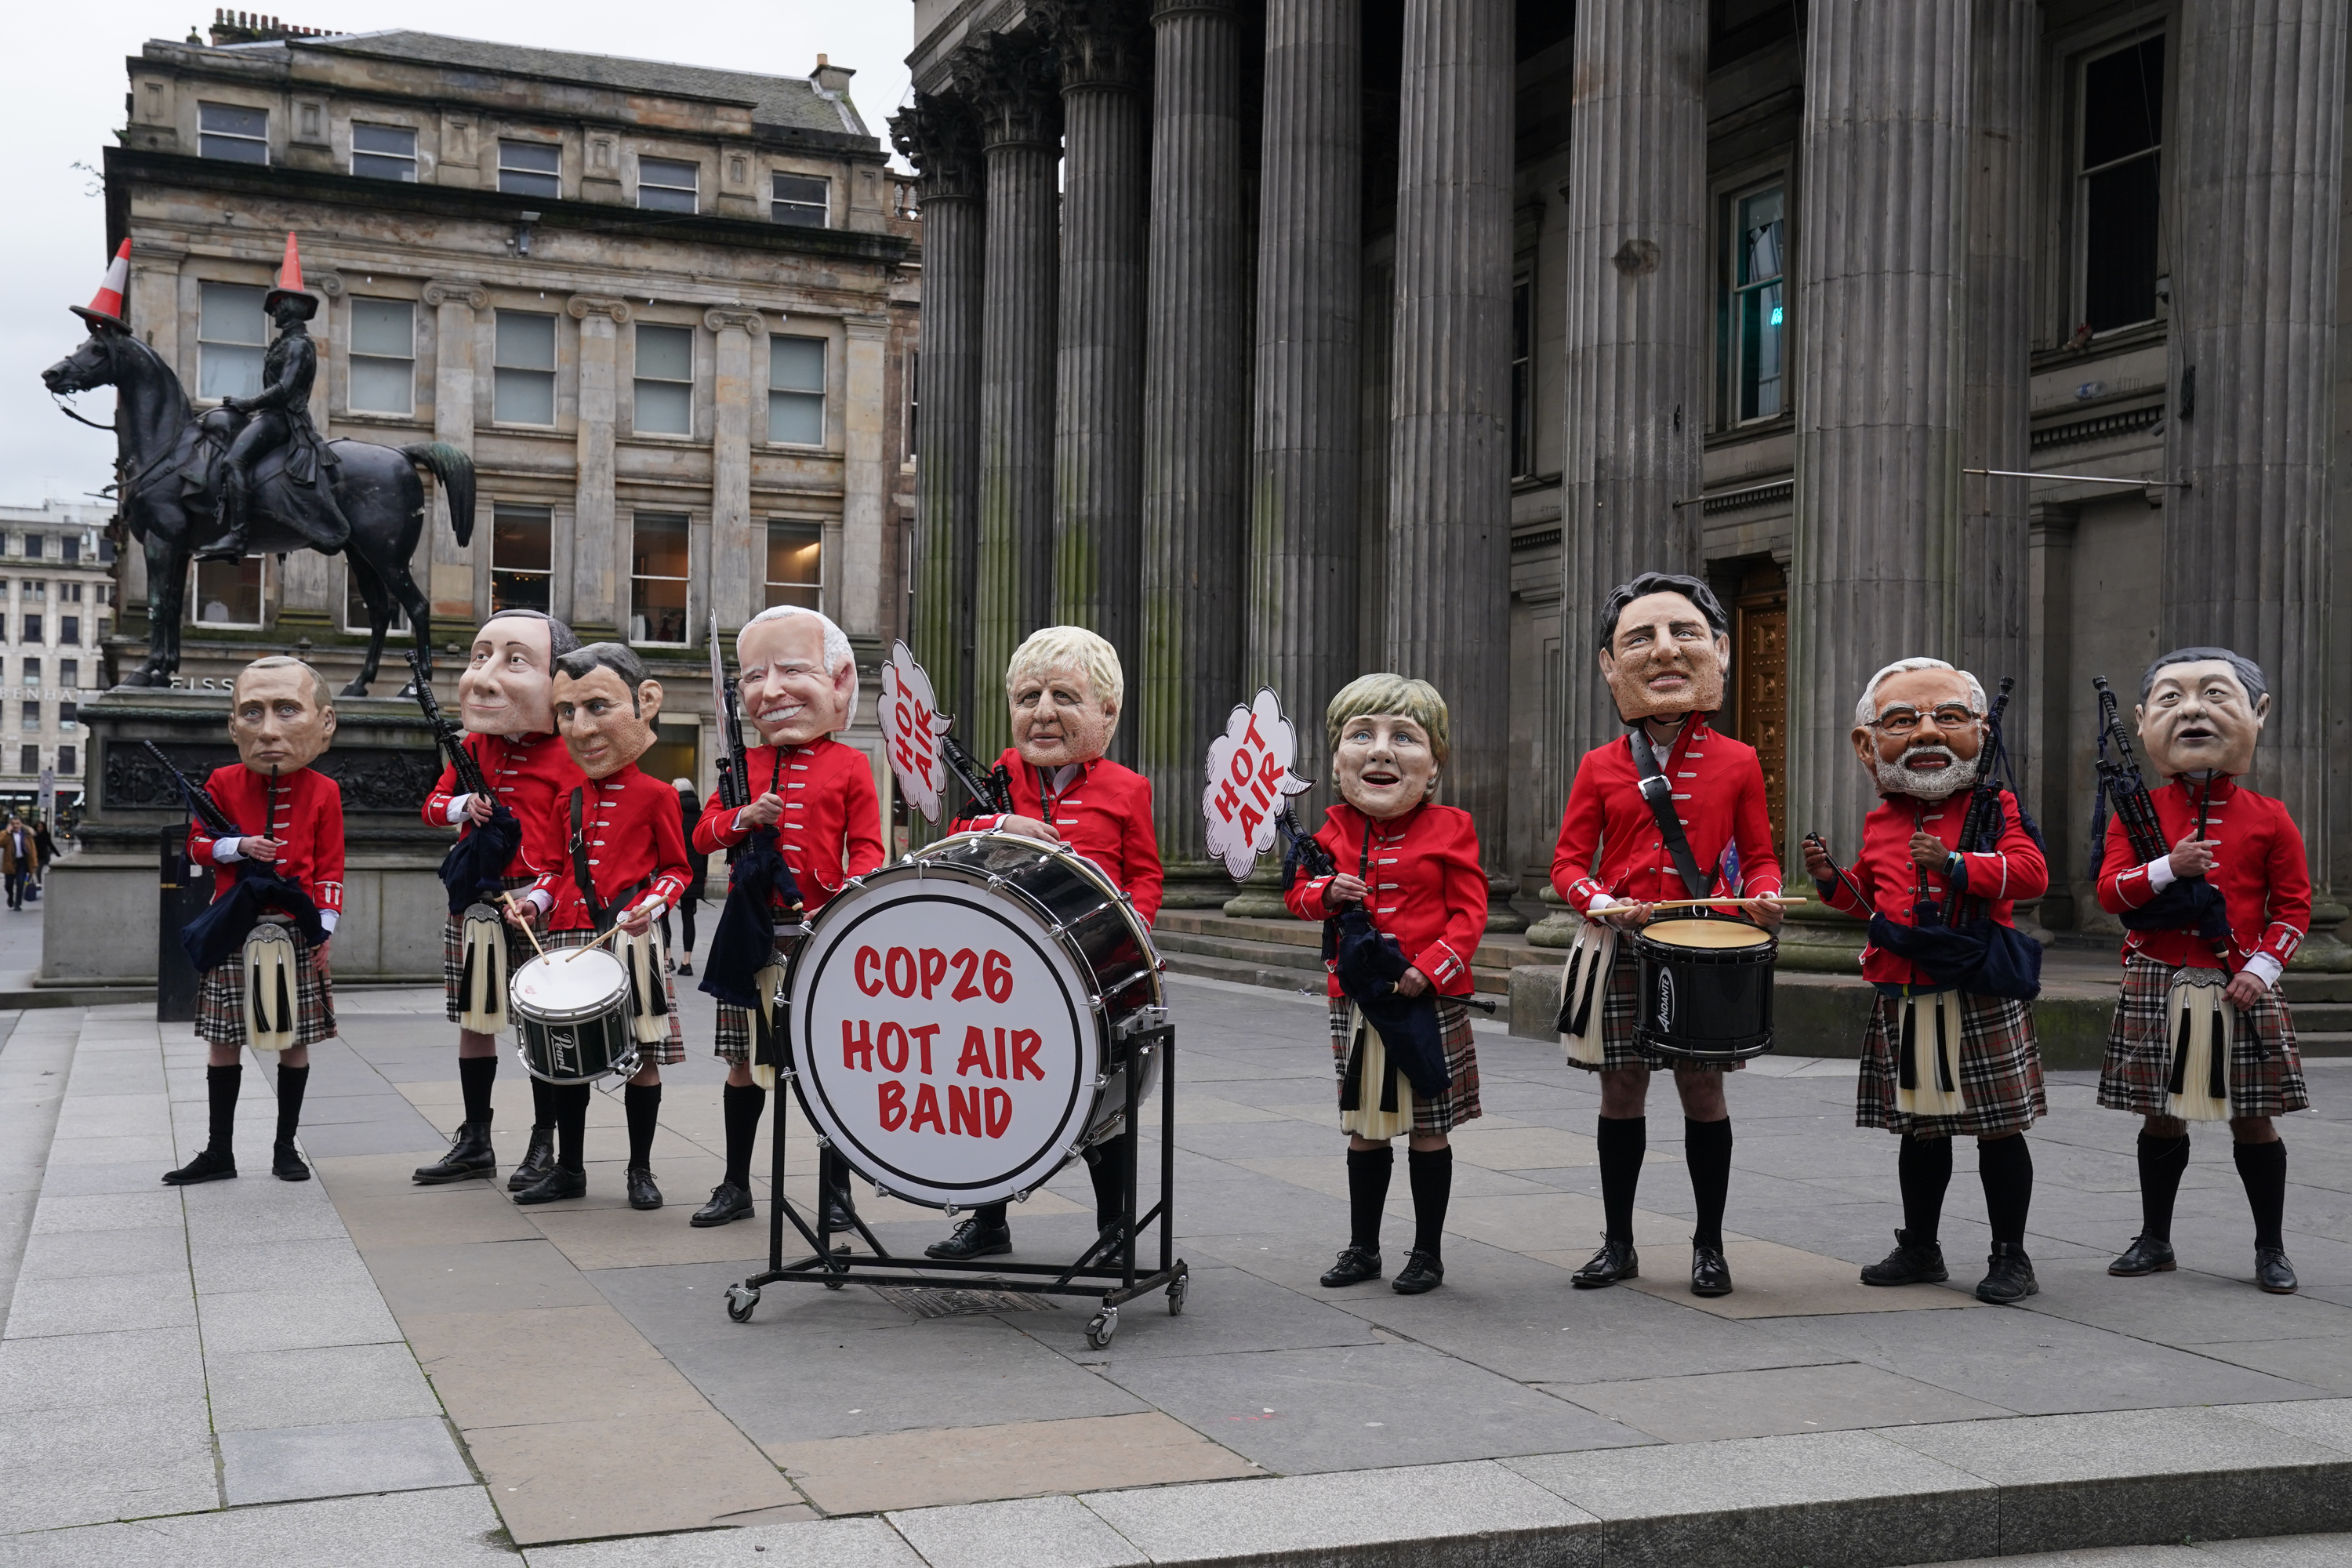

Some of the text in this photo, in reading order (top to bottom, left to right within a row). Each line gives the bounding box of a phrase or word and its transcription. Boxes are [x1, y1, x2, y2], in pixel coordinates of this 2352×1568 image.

[895, 666, 913, 774] HOT
[914, 699, 933, 793] AIR
[1214, 713, 1266, 824] HOT
[1239, 751, 1285, 849] AIR
[854, 945, 1014, 1004] COP26
[1657, 977, 1670, 1033] ANDANTE
[550, 1027, 575, 1073] Pearl
[841, 1019, 1046, 1081] HOT AIR
[877, 1080, 1013, 1139] BAND
